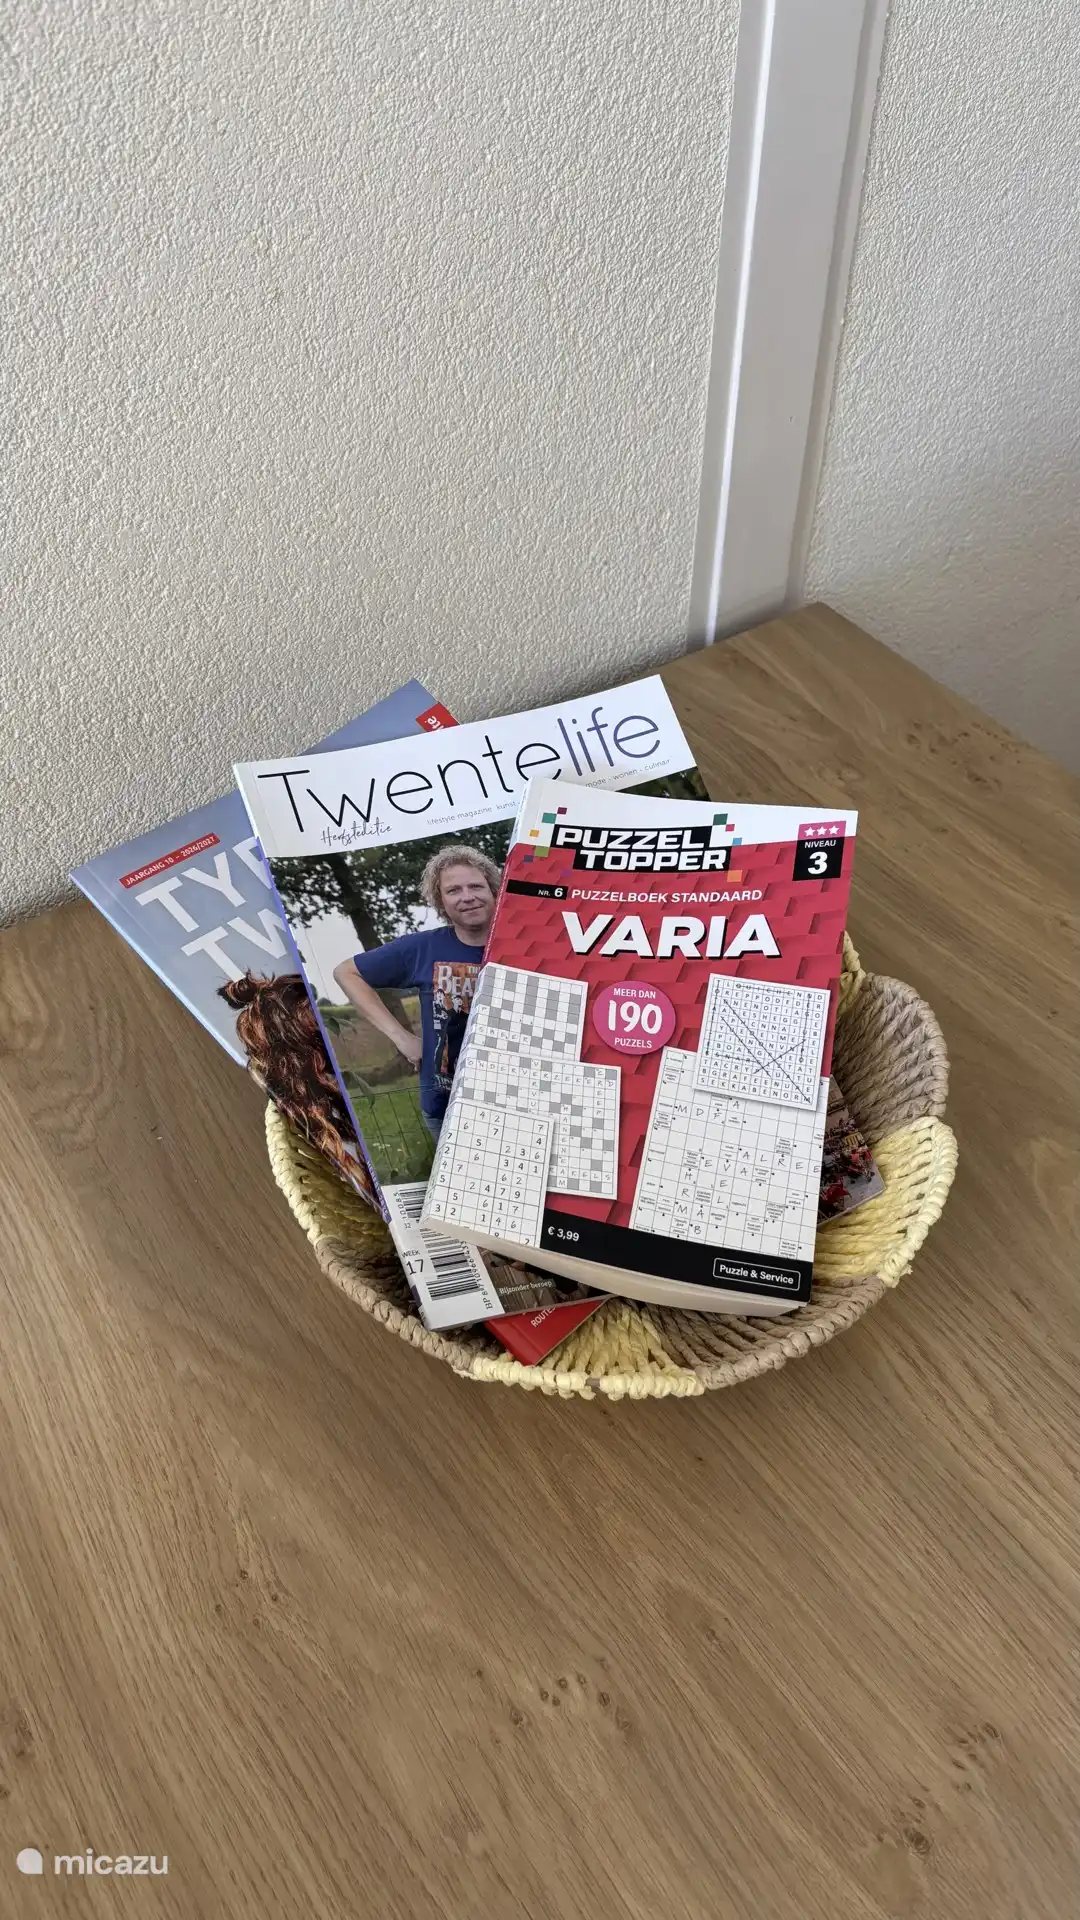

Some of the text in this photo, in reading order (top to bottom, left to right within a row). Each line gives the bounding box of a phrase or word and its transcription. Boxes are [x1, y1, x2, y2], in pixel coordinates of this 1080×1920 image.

[258, 707, 660, 833] Twentelife
[586, 778, 606, 787] mode
[613, 769, 637, 780] wonen
[644, 759, 670, 771] culinair
[427, 814, 455, 826] lifestyle
[457, 806, 492, 819] magazine
[496, 801, 516, 810] kunst
[320, 817, 393, 846] Herfsteditie
[556, 828, 704, 849] PUZZEL
[804, 839, 837, 849] NIVEAU
[125, 861, 165, 886] JAARGANG
[164, 856, 174, 864] 10
[180, 836, 215, 857] 2026/2027
[579, 850, 727, 871] TOPPER
[807, 851, 828, 875] 3
[538, 887, 763, 903] NR. 6 PUZZELBOEK STANDAARD
[561, 911, 781, 959] VARIA
[613, 987, 657, 999] MEER DAN
[608, 999, 663, 1035] 190
[614, 1037, 653, 1048] PUZZELS
[548, 1226, 580, 1242] € 3,99
[402, 1249, 420, 1259] WEEK
[406, 1258, 424, 1275] 17
[719, 1263, 794, 1285] Puzzle & Service
[499, 1280, 553, 1296] Bijzonder beroep
[530, 1307, 556, 1328] ROUTE
